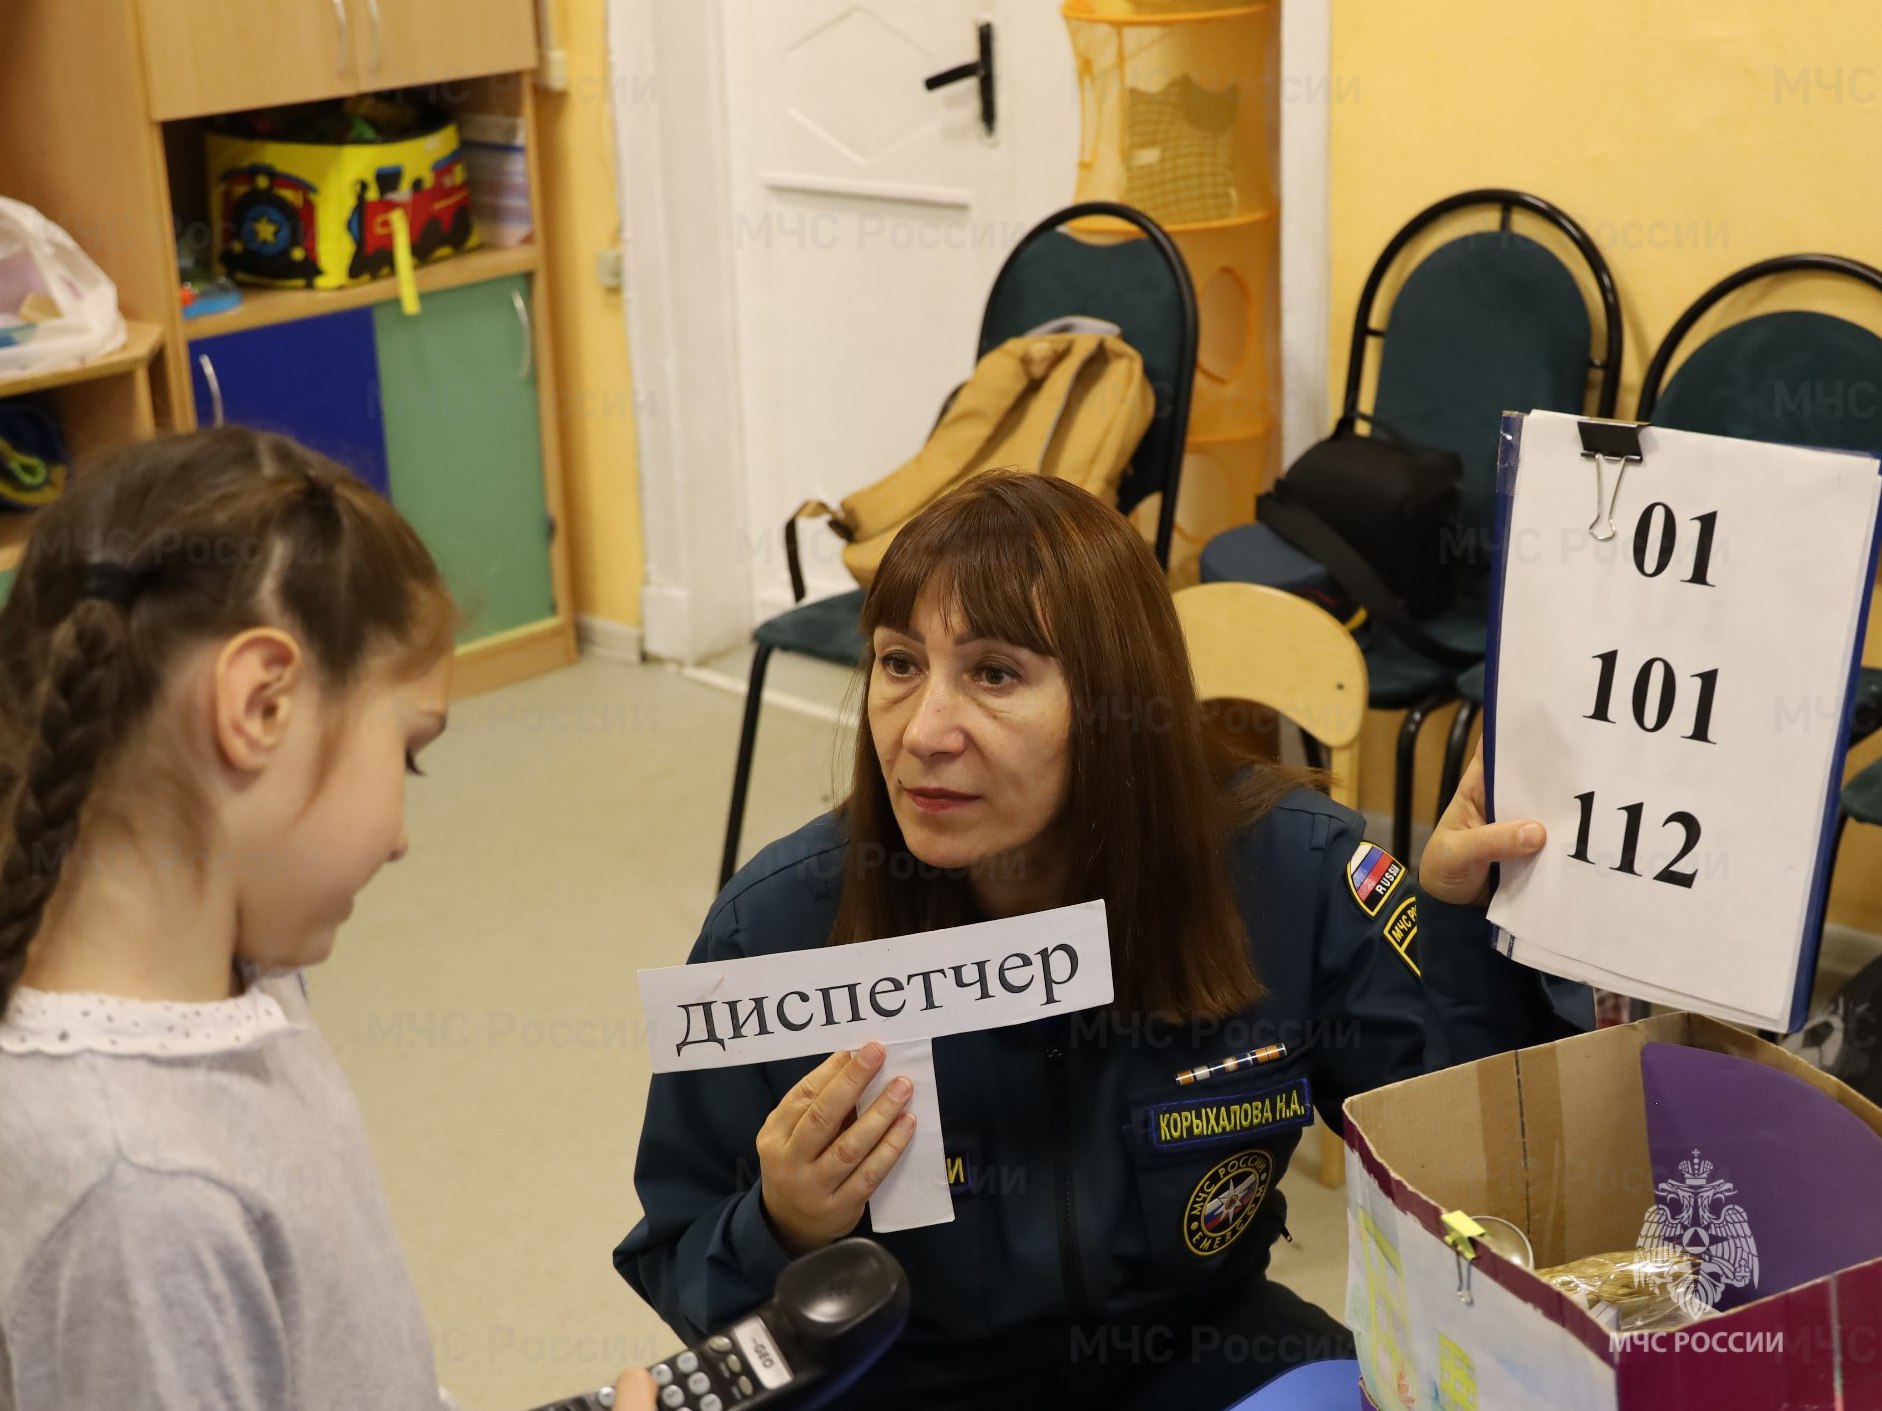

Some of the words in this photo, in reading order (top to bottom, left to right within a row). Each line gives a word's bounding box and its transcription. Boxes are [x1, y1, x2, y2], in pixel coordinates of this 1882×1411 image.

[1632, 501, 1719, 588] 01
[1582, 649, 1719, 745] 101
[1567, 790, 1702, 889] 112
[1391, 915, 1411, 942] МЧС
[676, 942, 1079, 1057] диспетчер
[1159, 1097, 1272, 1141] КОРЫХАЛОВА
[1276, 1089, 1306, 1121] Н.А.
[1191, 1181, 1215, 1215] МЧС
[1218, 1155, 1267, 1179] РОССИИ
[1192, 1184, 1264, 1250] EMERCOM
